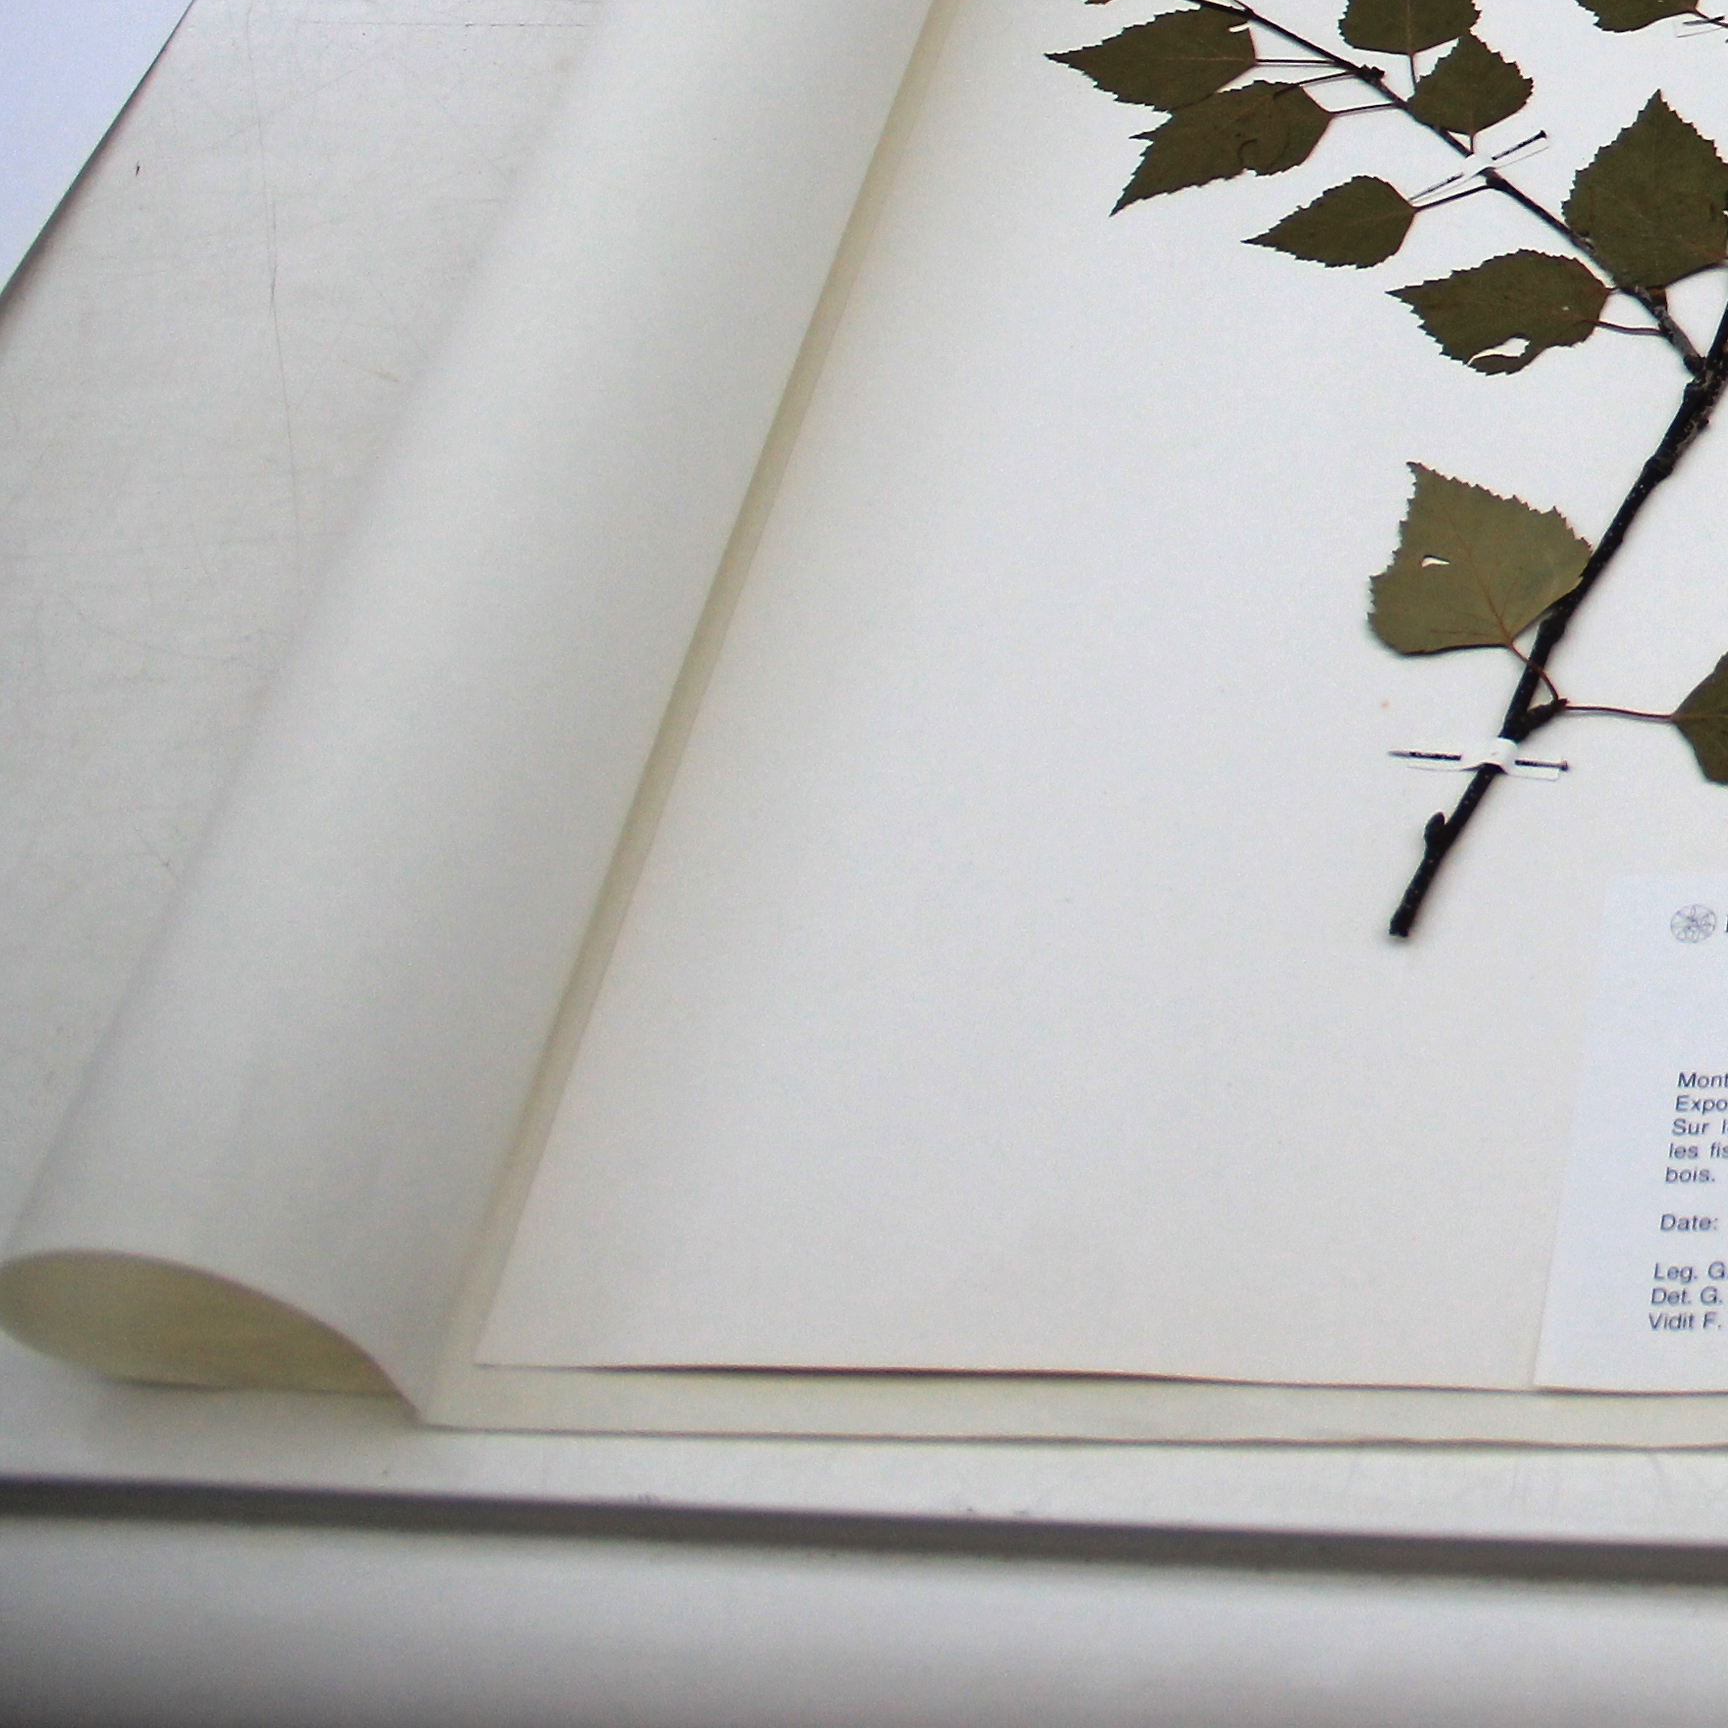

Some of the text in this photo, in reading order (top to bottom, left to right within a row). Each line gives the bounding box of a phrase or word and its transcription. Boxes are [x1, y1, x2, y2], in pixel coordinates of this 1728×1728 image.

[1671, 1118, 1709, 1137] Sur
[1668, 1142, 1699, 1160] les
[1664, 1166, 1716, 1184] bois.
[1659, 1214, 1719, 1232] Date:
[1653, 1262, 1698, 1284] Leg.
[1650, 1287, 1690, 1305] Det.
[1700, 1287, 1723, 1305] G.
[1648, 1312, 1694, 1330] Vidit
[1702, 1312, 1722, 1329] F.
